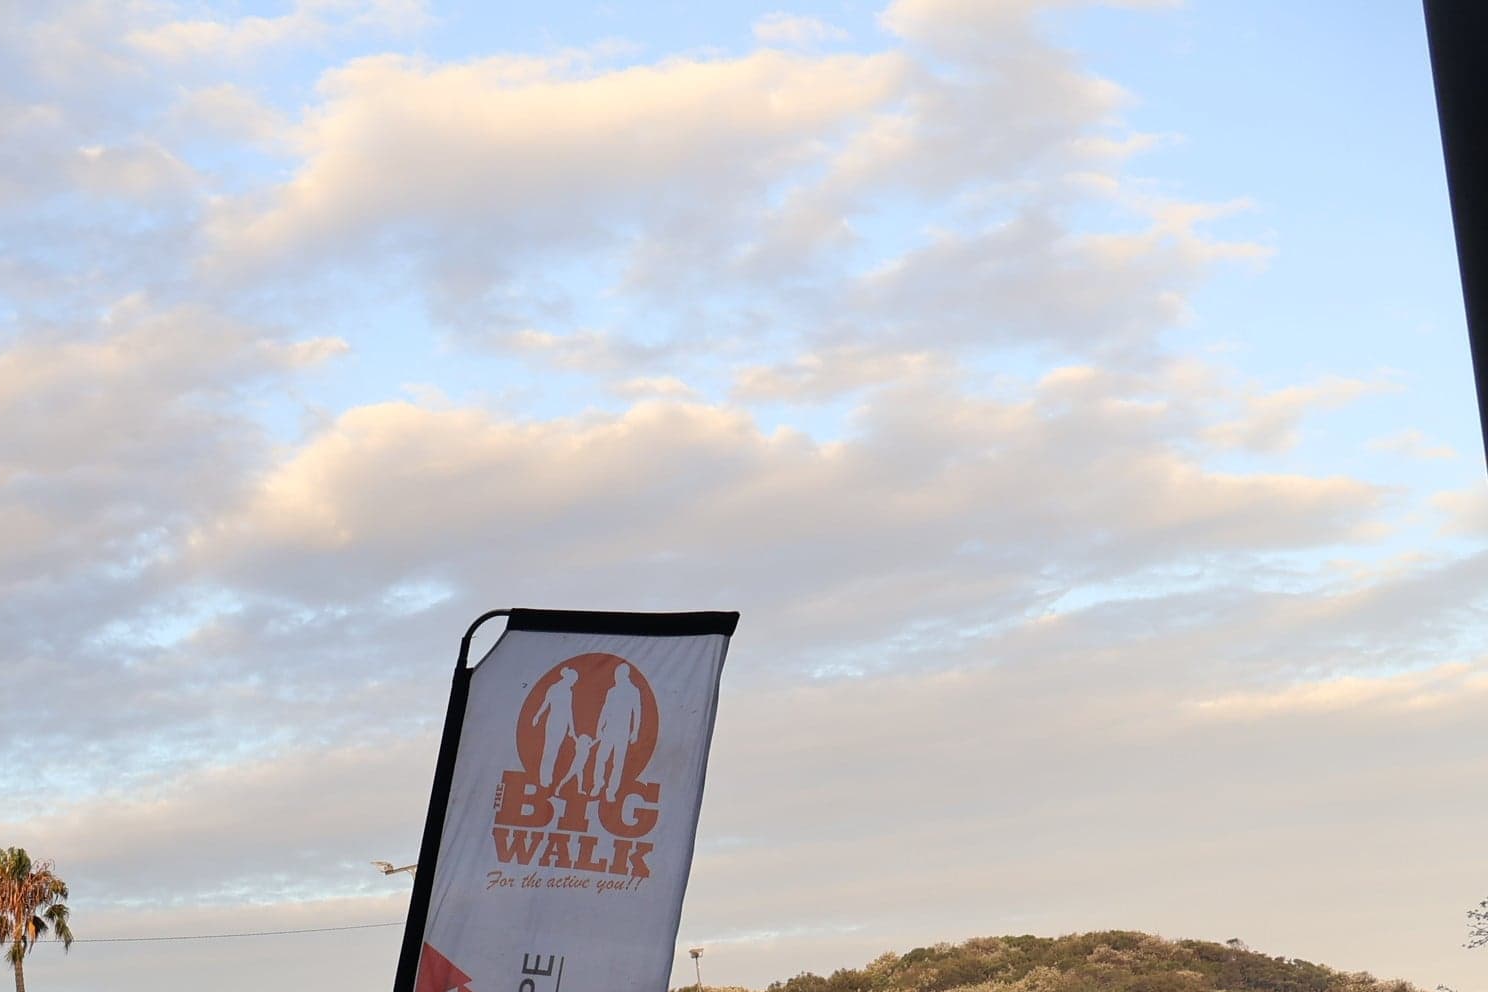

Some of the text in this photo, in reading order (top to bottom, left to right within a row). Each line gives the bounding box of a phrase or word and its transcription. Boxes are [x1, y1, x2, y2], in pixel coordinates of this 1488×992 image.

[493, 783, 505, 811] THE
[494, 770, 661, 838] BIG
[492, 827, 654, 878] WALK
[487, 870, 515, 890] For
[521, 871, 542, 888] the
[546, 875, 590, 889] active
